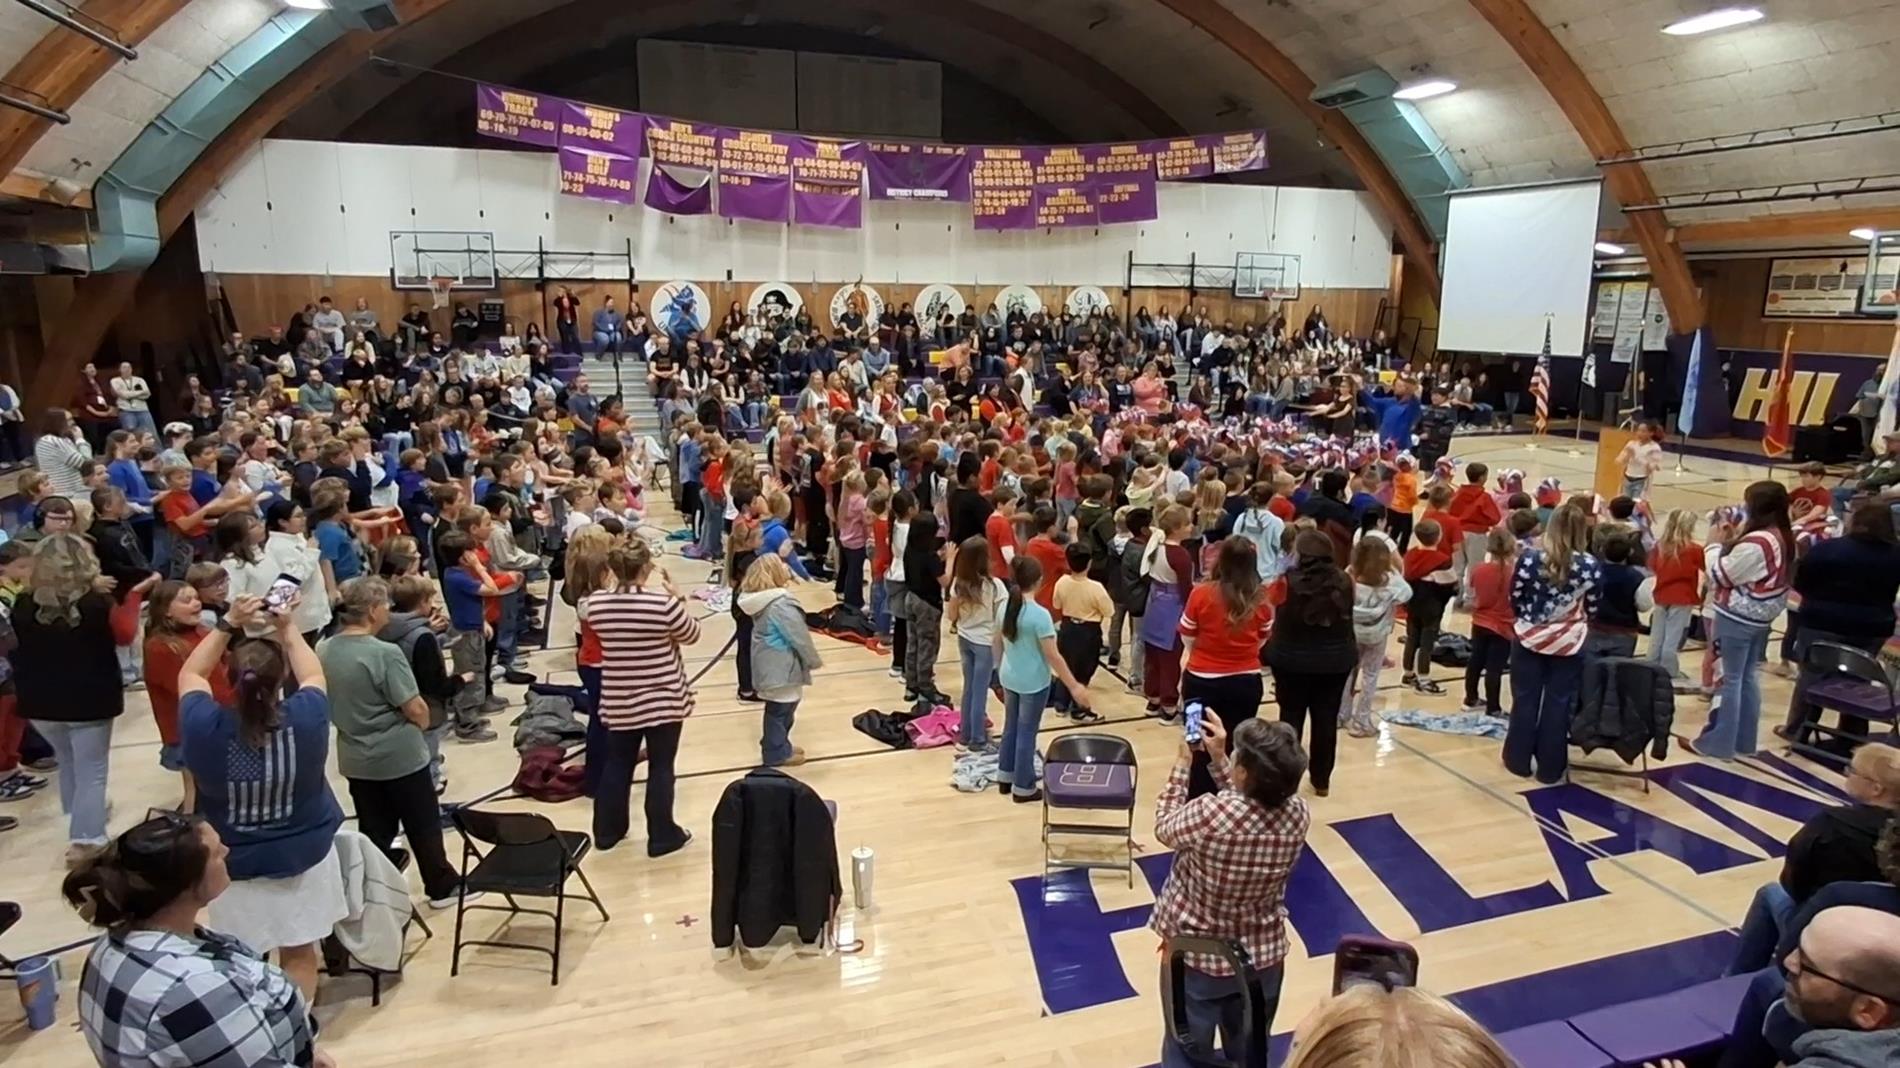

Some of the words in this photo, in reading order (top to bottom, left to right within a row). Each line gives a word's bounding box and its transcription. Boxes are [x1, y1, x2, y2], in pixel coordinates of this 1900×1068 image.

[590, 116, 614, 130] GOLF
[647, 127, 676, 141] CROSS
[676, 131, 716, 147] COUNTRY
[722, 138, 750, 151] CROSS
[751, 141, 789, 155] COUNTRY
[587, 163, 610, 176] GOLF
